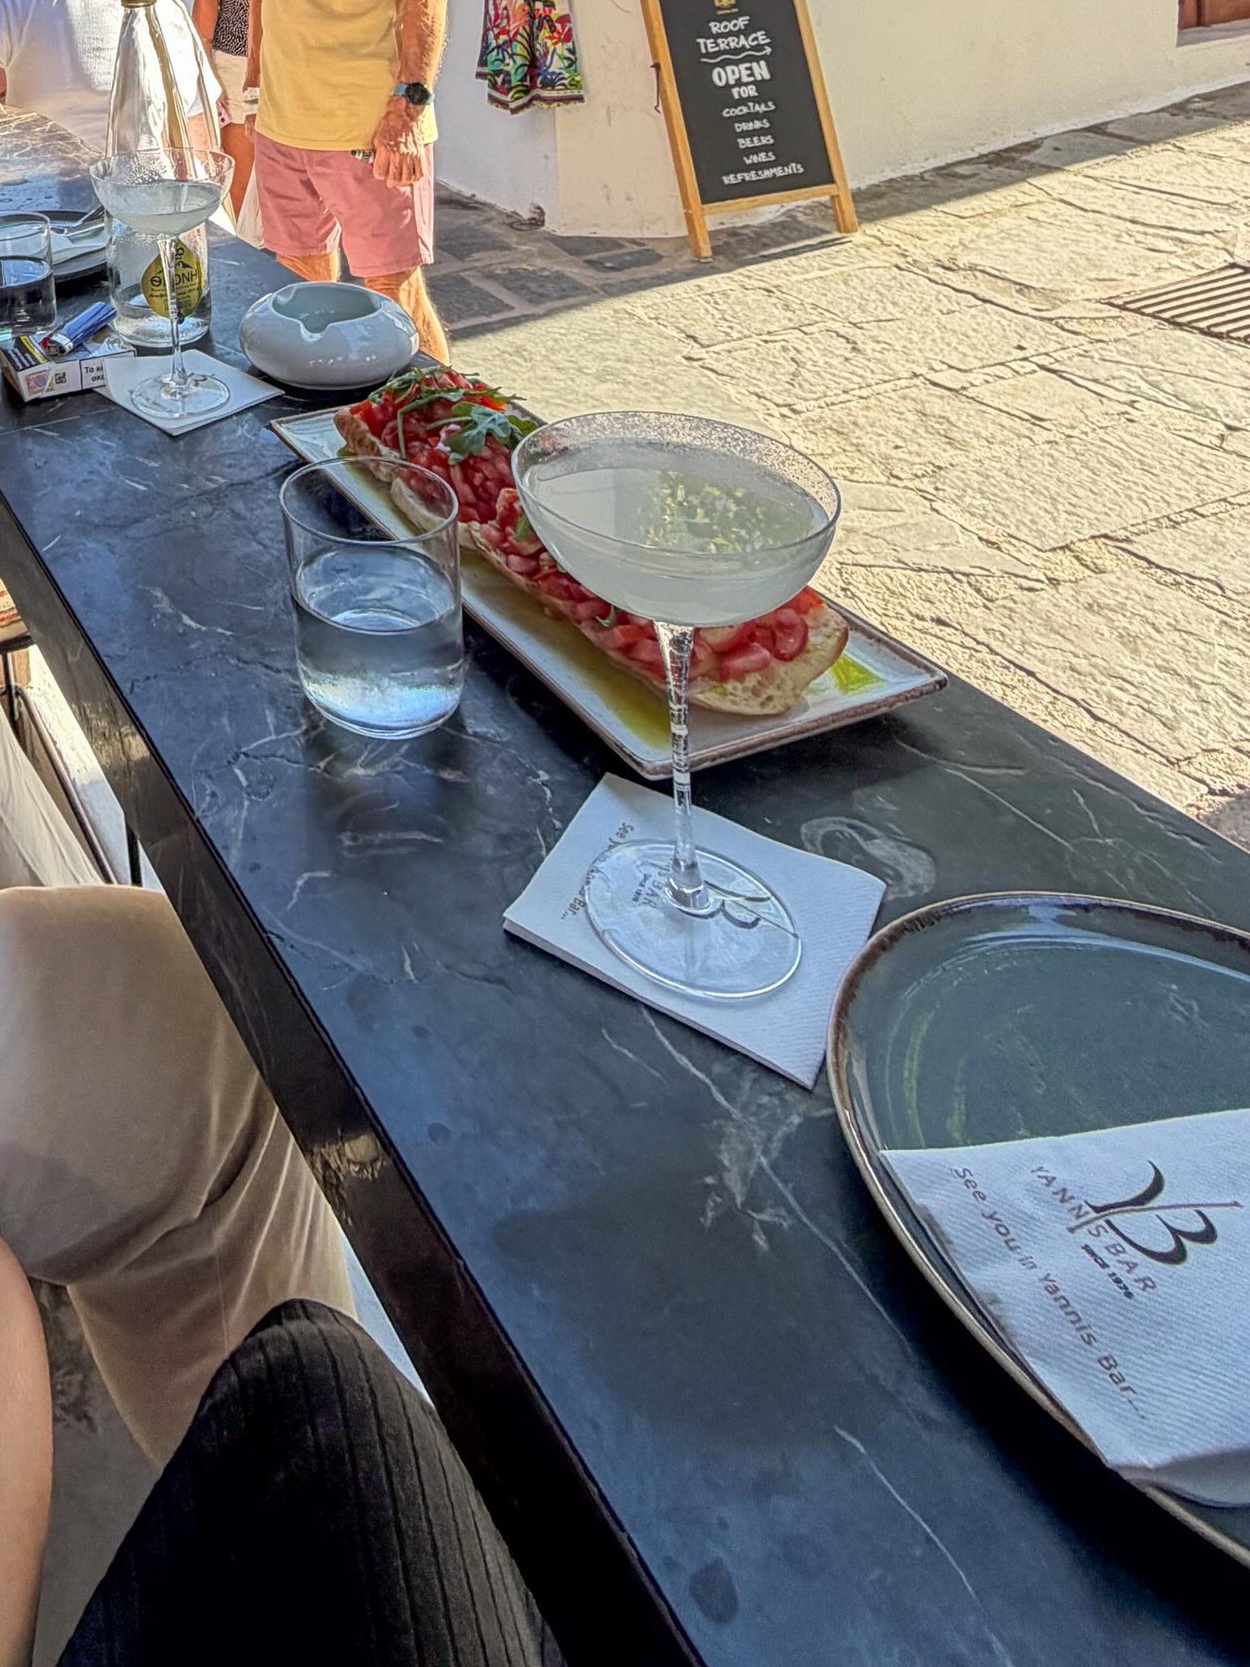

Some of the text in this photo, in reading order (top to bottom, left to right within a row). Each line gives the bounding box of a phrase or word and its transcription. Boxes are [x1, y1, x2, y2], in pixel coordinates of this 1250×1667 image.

[709, 16, 750, 34] ROOF
[696, 31, 771, 53] TERRACE
[712, 60, 771, 87] OPEN
[731, 85, 758, 99] FOR
[734, 119, 770, 132] DRINKS
[737, 136, 774, 149] BEERS
[743, 152, 776, 165] WINES
[722, 163, 804, 184] REFRESHMENTS
[953, 1167, 987, 1202] See
[981, 1210, 1020, 1252] you
[1018, 1255, 1038, 1271] in
[1038, 1272, 1098, 1347] Yannis
